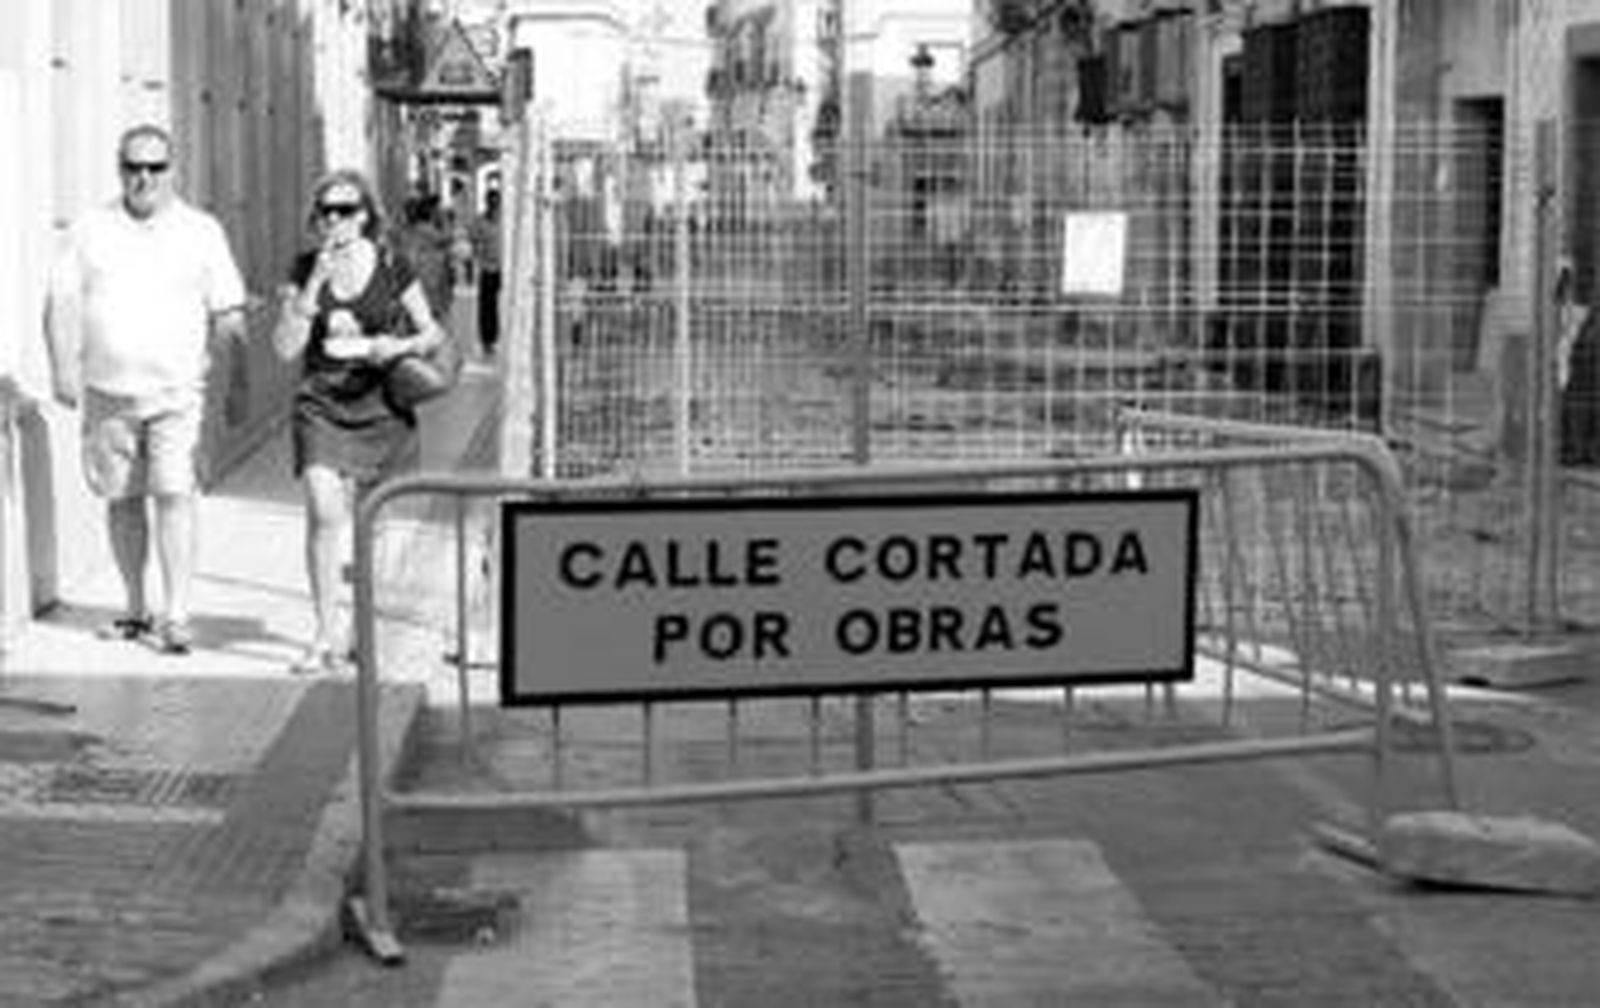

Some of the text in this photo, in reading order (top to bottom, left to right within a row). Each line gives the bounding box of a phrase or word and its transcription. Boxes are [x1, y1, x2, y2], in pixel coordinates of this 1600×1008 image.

[558, 531, 1149, 590] CALLE CORTADA
[652, 602, 1065, 664] POR OBRAS
